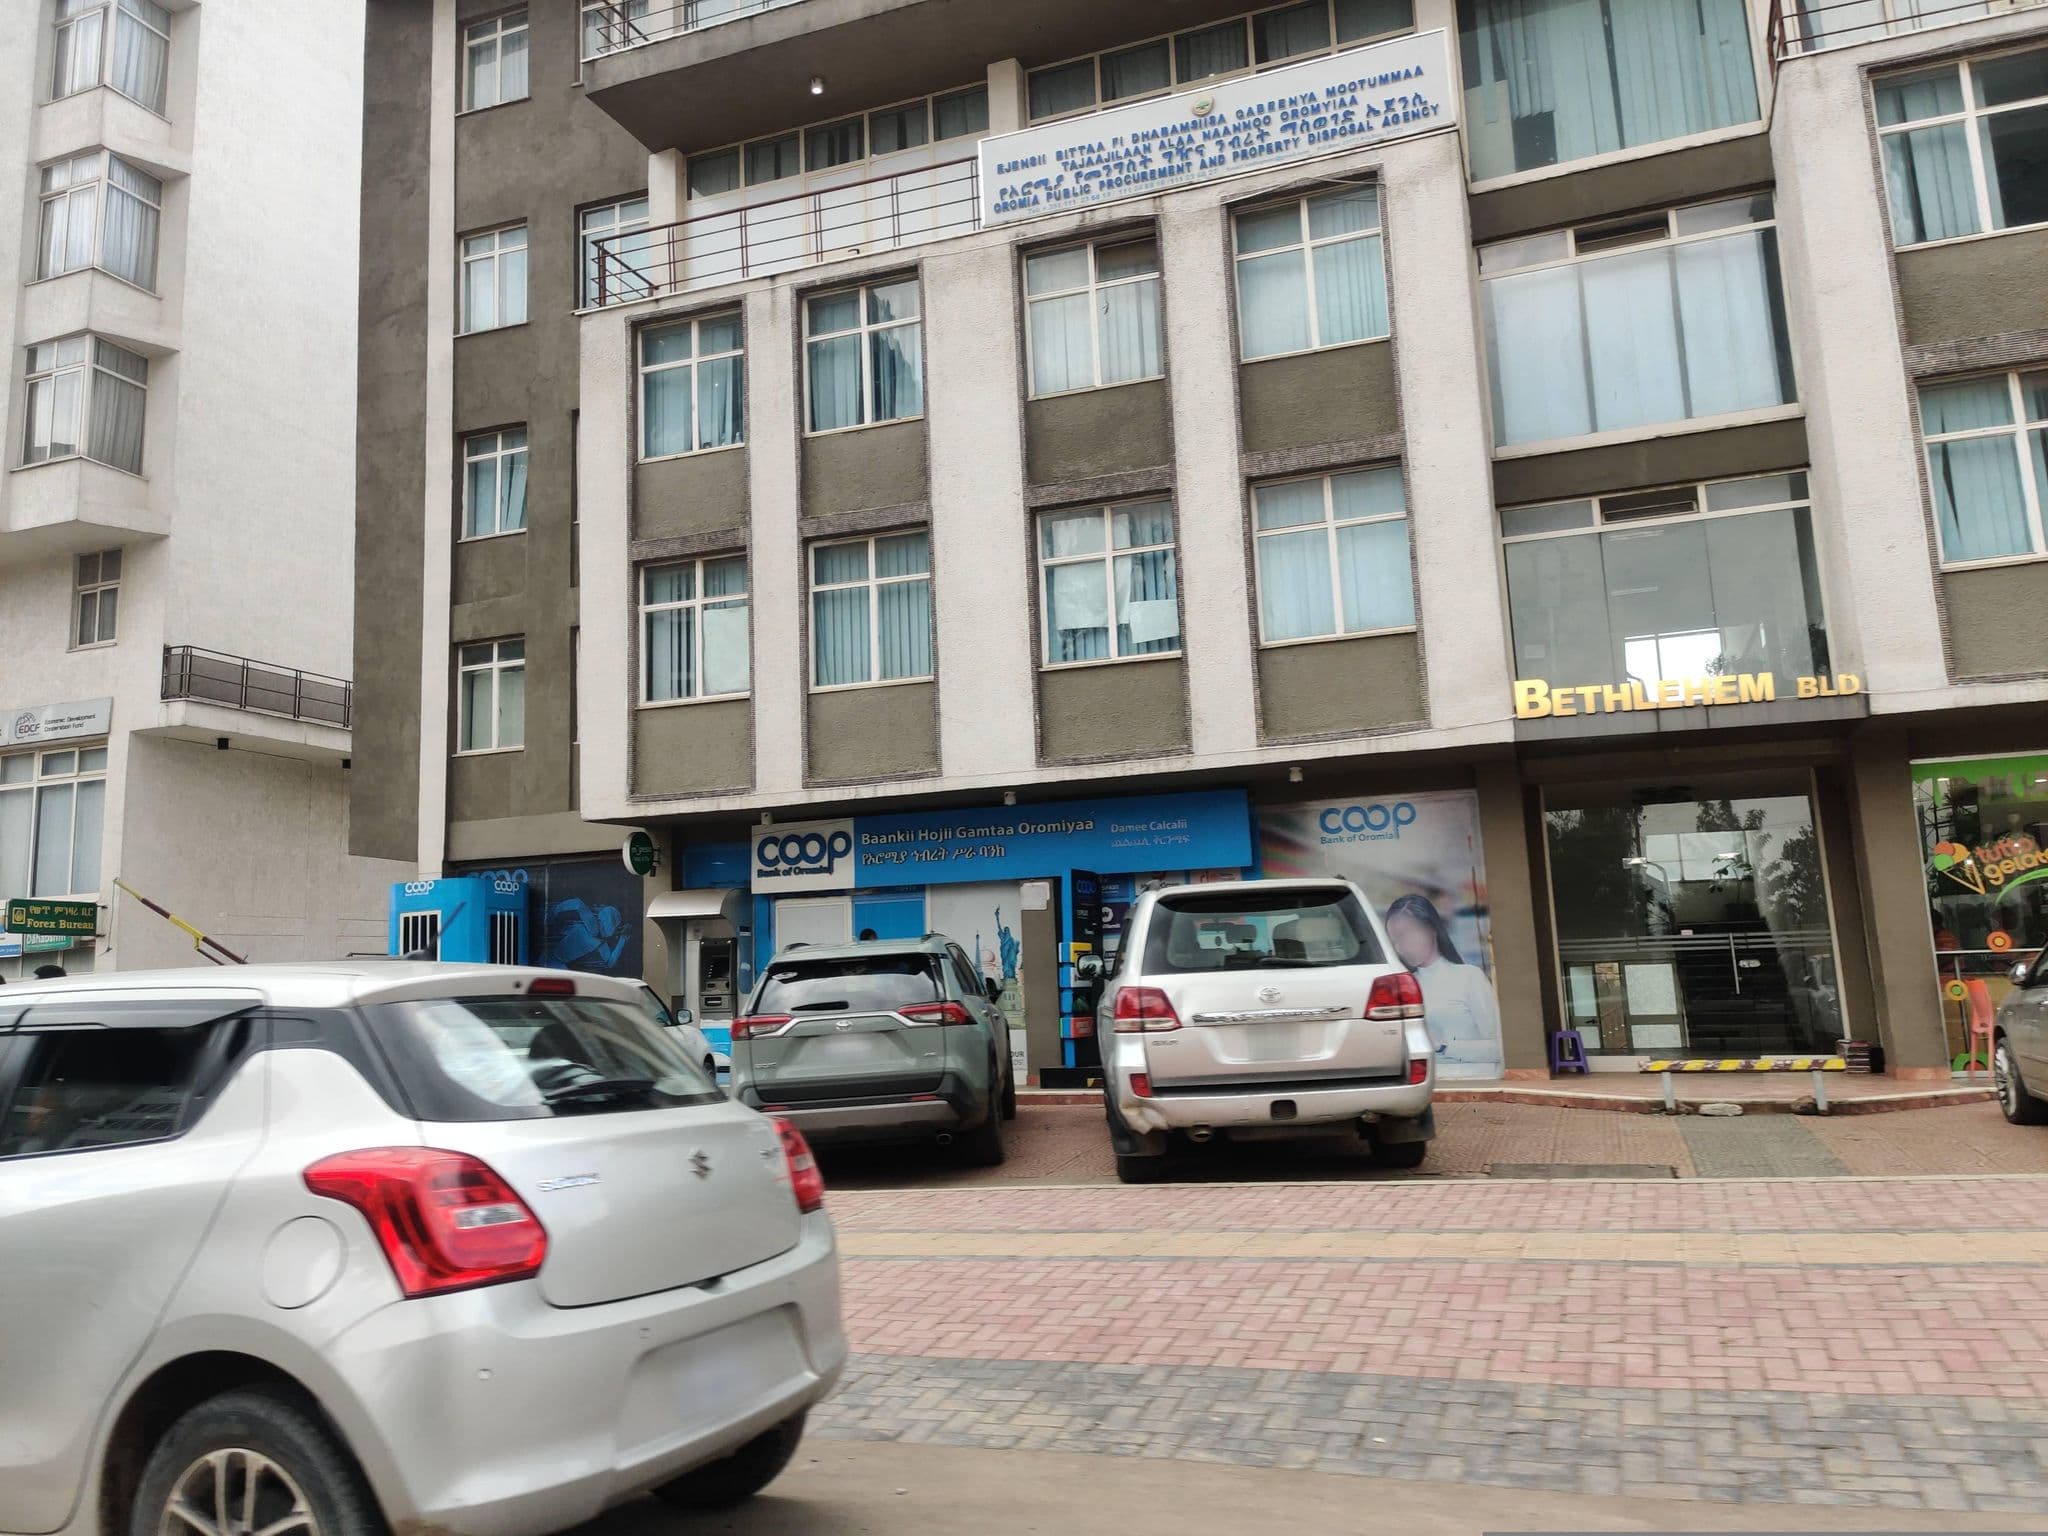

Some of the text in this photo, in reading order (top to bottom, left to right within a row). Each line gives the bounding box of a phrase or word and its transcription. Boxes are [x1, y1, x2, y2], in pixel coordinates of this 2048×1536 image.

[1056, 140, 1106, 161] BITTAA
[1326, 65, 1424, 98] MOOTUMMAA
[1063, 143, 1152, 172] TAJAAJILAAN
[1202, 115, 1272, 140] NAANNOO
[1280, 95, 1359, 122] OROMYIAA
[994, 196, 1040, 214] OROMIA
[1047, 185, 1091, 202] PUBLIC
[1099, 162, 1193, 191] PROCUREMENT
[1200, 154, 1225, 168] AND
[1233, 137, 1301, 161] PROPERTY
[1308, 121, 1374, 144] DISPOSAL
[1382, 106, 1441, 128] AGENCY
[1797, 673, 1860, 699] BLD
[19, 723, 40, 734] EDCF
[861, 830, 915, 846] Baankii
[955, 822, 1015, 839] Gamtaa
[1018, 817, 1094, 837] Oromiyaa
[1111, 823, 1148, 833] Damee
[1320, 832, 1394, 844] Bank of Oromia
[1984, 847, 2048, 886] gelat
[26, 918, 94, 929] Forex Bureau
